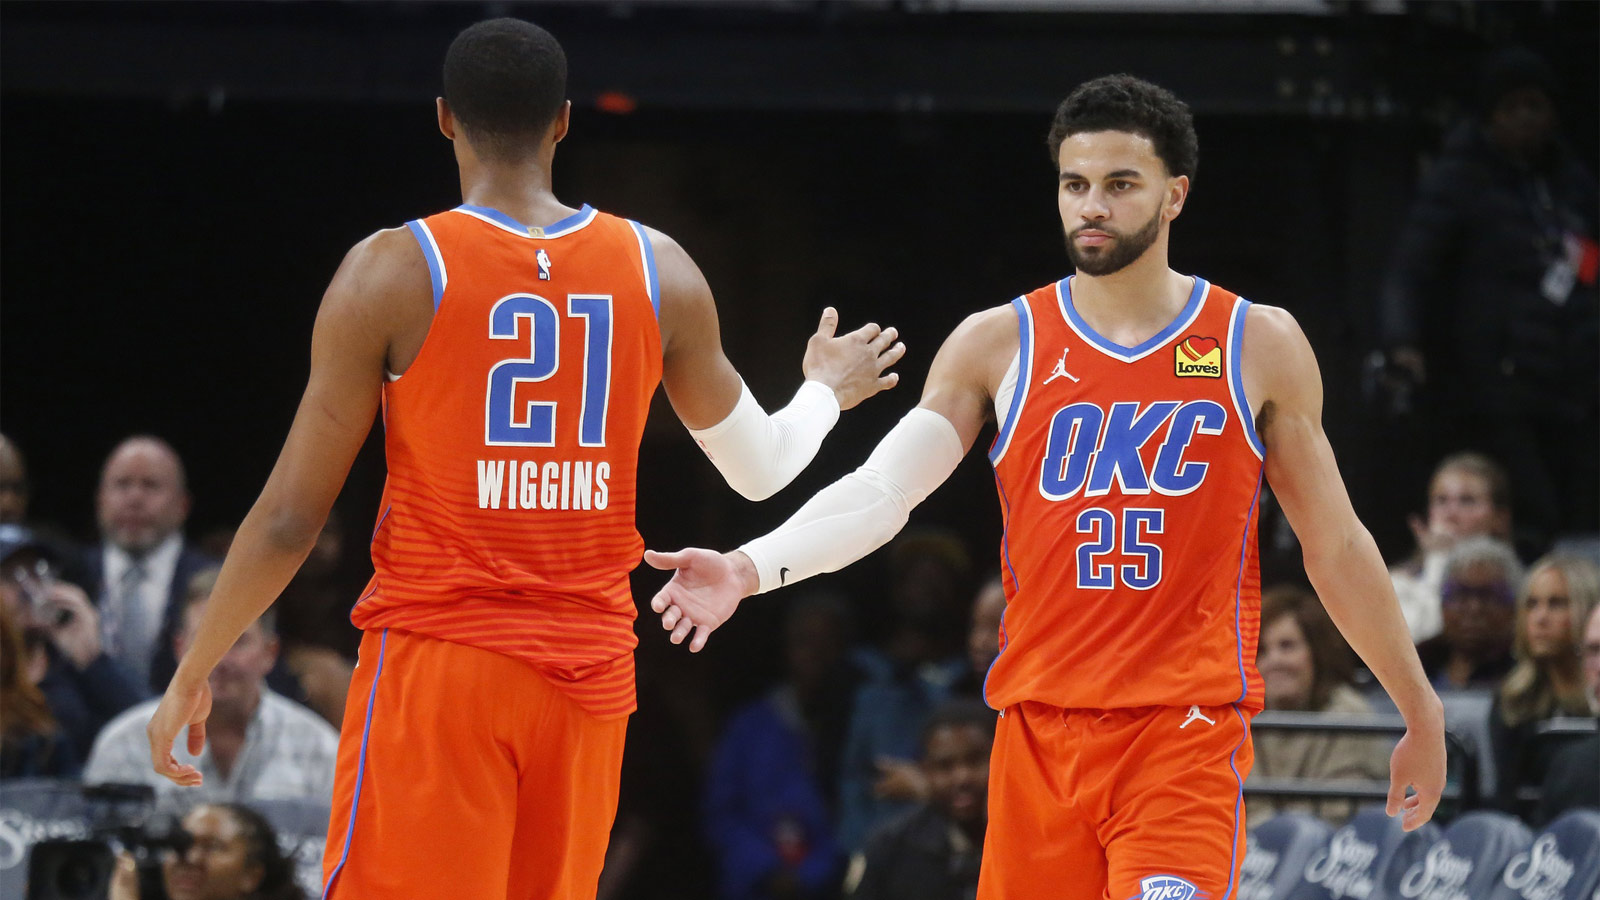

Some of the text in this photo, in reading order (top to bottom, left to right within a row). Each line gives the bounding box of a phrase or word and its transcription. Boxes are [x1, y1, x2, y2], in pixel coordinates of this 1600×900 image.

[485, 293, 613, 447] 21
[477, 460, 610, 510] WIGGINS
[1039, 400, 1228, 502] OKC
[1076, 507, 1165, 591] 25
